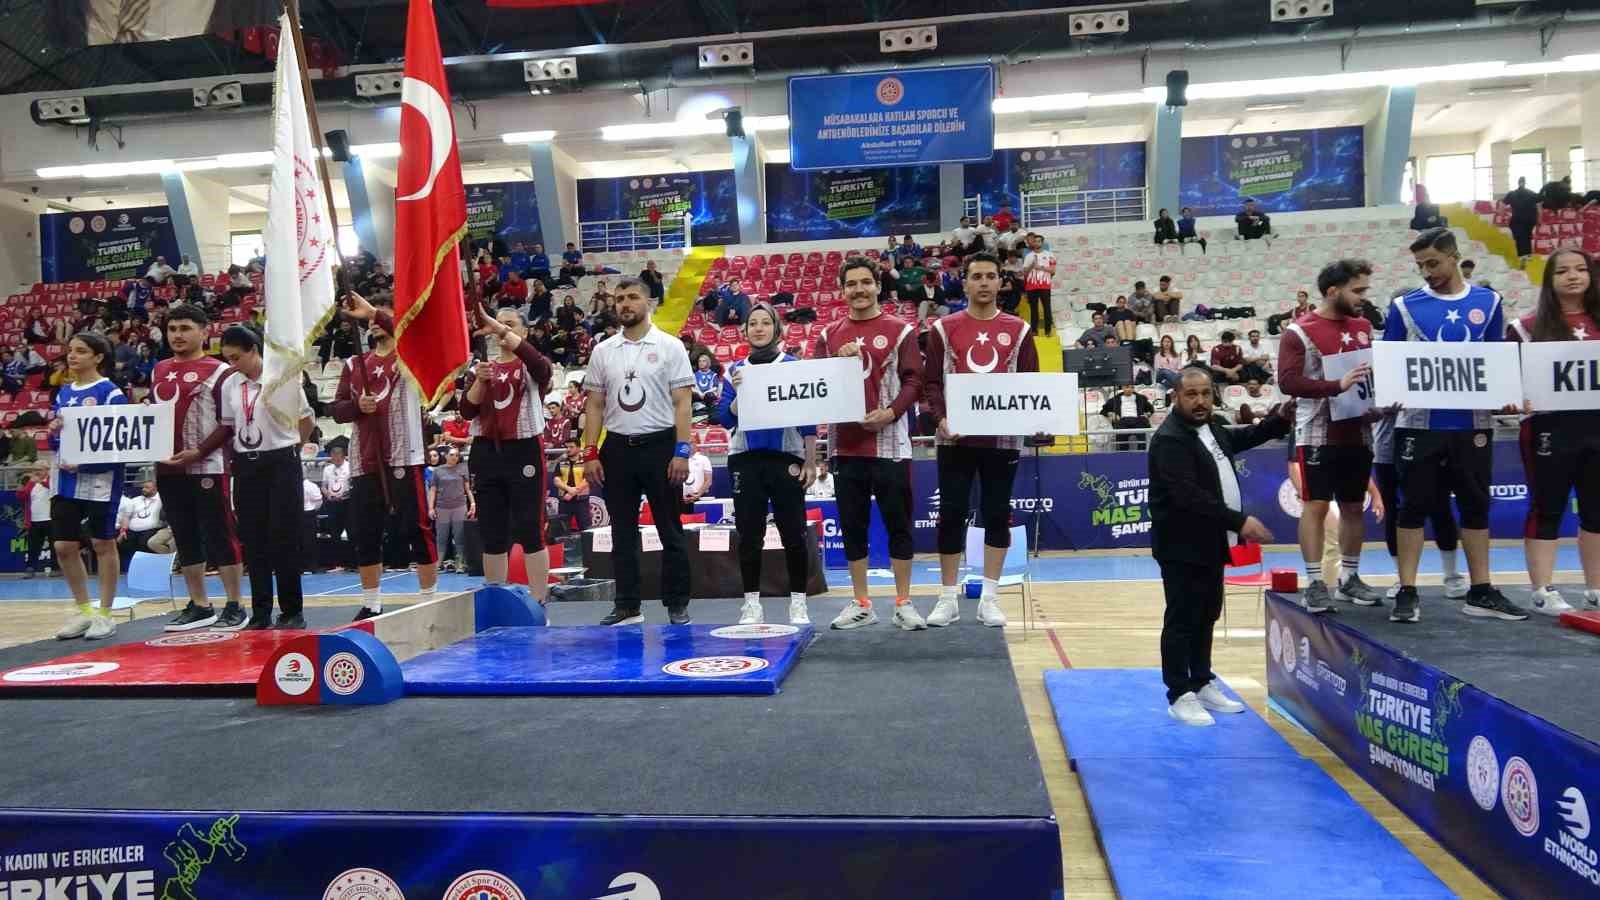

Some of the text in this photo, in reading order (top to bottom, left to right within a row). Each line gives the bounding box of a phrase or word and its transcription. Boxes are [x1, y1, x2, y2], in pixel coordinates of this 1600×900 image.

[917, 108, 948, 121] SPORCU
[948, 107, 959, 119] VE
[767, 377, 829, 402] ELAZIĞ
[971, 395, 1052, 411] MALATYA
[77, 415, 155, 452] YOZGAT
[1092, 506, 1141, 526] MAS
[5, 845, 144, 872] KADIN VE ERKEKLER
[1559, 829, 1598, 867] WORLD
